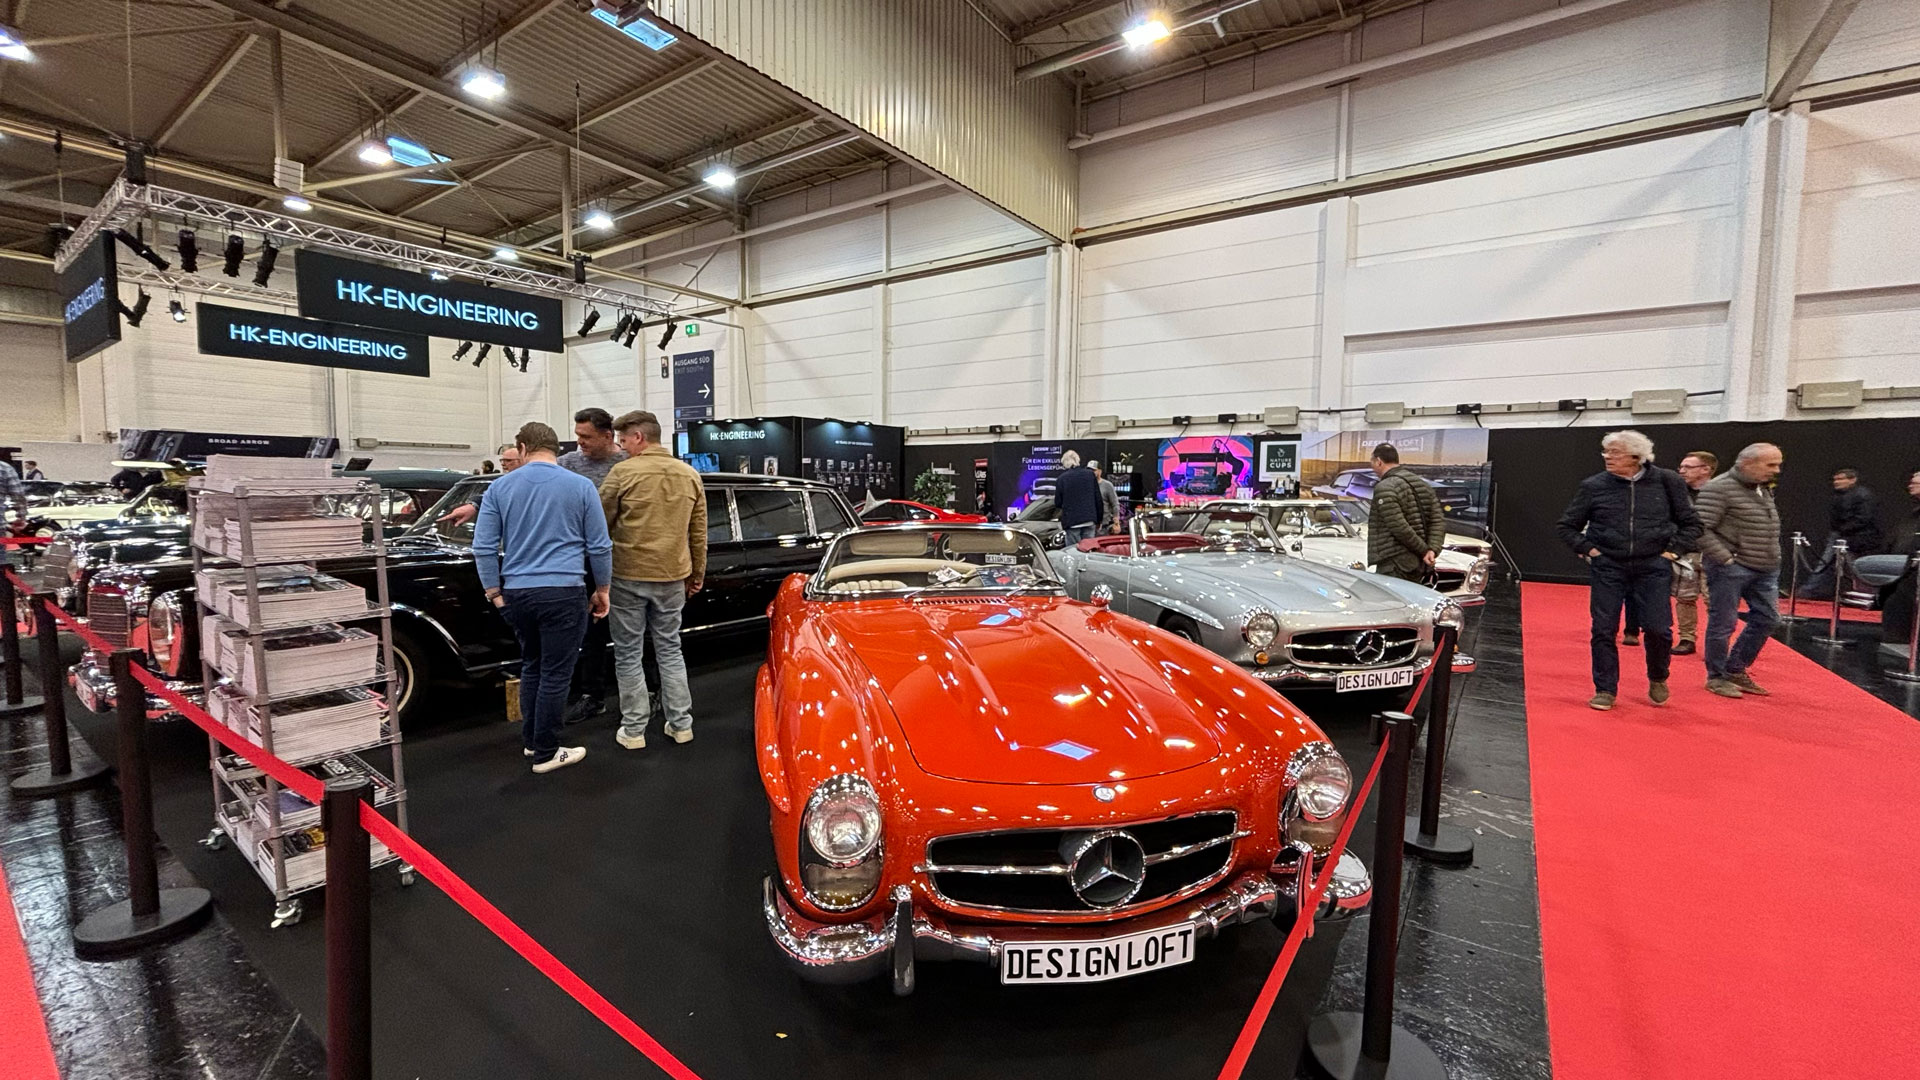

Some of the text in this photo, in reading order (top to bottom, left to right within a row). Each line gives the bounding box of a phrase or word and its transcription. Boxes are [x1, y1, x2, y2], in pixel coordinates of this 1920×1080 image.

[337, 279, 539, 331] HK-ENGINEERING
[230, 323, 407, 360] HK-ENGINEERING
[674, 357, 698, 366] AUSGANG
[710, 430, 766, 441] HK-ENGINEERING
[1339, 670, 1412, 690] DESIGN LOFT
[1006, 929, 1193, 979] DESIGN LOFT
